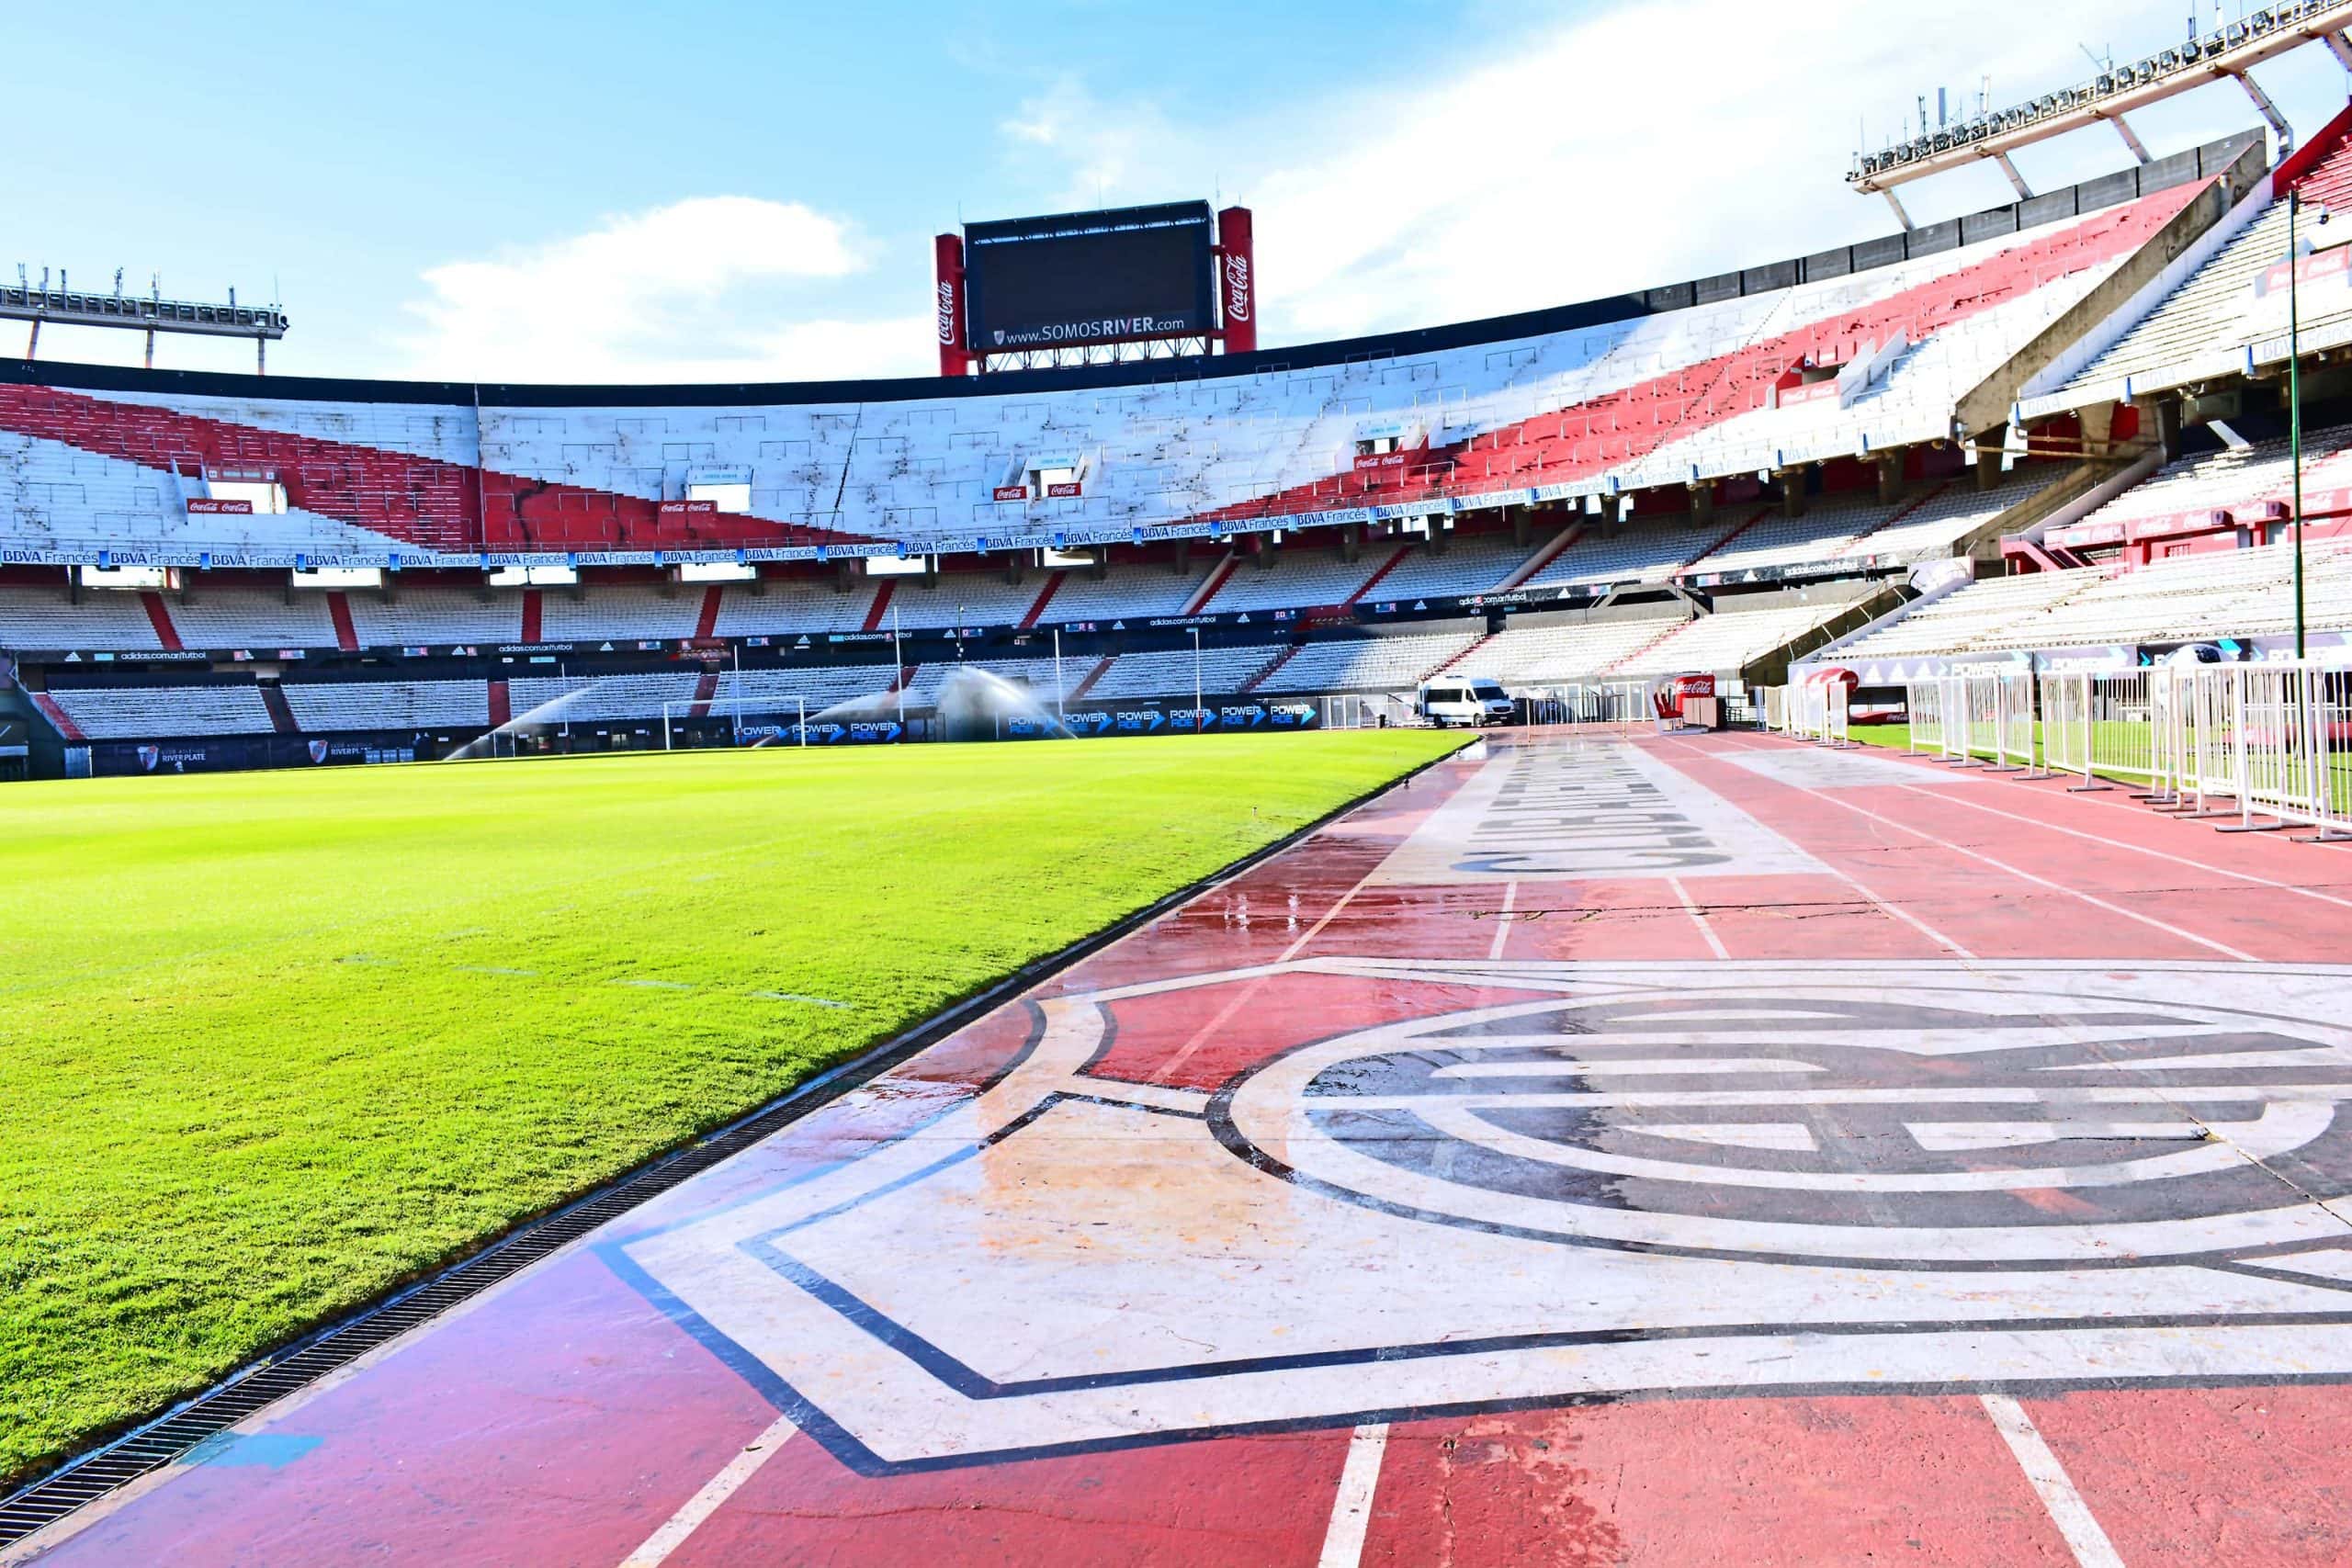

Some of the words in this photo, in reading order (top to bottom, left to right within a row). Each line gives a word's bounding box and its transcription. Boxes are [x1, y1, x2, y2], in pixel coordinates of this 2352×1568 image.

[1228, 254, 1249, 321] Coca-Cola
[937, 280, 956, 345] Coca-Cola
[1007, 317, 1184, 344] www.SOMOSRIVER.com
[1297, 513, 1324, 525] BBVA
[1327, 508, 1367, 524] Francés
[1376, 505, 1404, 517] BBVA
[1220, 520, 1247, 532] BBVA
[1250, 517, 1288, 530] Francés
[1064, 532, 1091, 544] BBVA
[1093, 529, 1133, 542] Francés
[1141, 527, 1169, 538] BBVA
[1171, 525, 1211, 536] Francés
[905, 541, 933, 552] BBVA
[935, 538, 976, 550] Francés
[986, 537, 1013, 548] BBVA
[1015, 535, 1055, 547] Francés
[662, 551, 692, 562] BBVA
[695, 549, 736, 561] Francés
[745, 549, 773, 559] BBVA
[775, 547, 817, 558] Francés
[828, 546, 855, 557] BBVA
[857, 544, 898, 556] Francés
[3, 551, 41, 562] BBVA
[46, 551, 97, 563] Francés
[111, 553, 147, 564] BBVA
[151, 552, 199, 565] Francés
[212, 555, 246, 566] BBVA
[249, 554, 297, 566] Francés
[306, 555, 339, 566] BBVA
[342, 554, 388, 566] Francés
[401, 555, 433, 566] BBVA
[435, 555, 480, 566] Francés
[490, 554, 521, 565] BBVA
[523, 553, 567, 565] Francés
[577, 553, 606, 563] BBVA
[609, 552, 652, 563] Francés
[1150, 616, 1216, 626] adidas.com.ar/futbol
[499, 643, 572, 652] adidas.com.ar/futbol
[121, 651, 206, 660] adidas.com.ar/futbol
[1170, 709, 1211, 719] POWER
[1221, 705, 1261, 716] POWER
[1271, 705, 1310, 715] POWER
[1063, 713, 1108, 723] POWER
[1116, 712, 1159, 721] POWER
[850, 722, 897, 731] POWER
